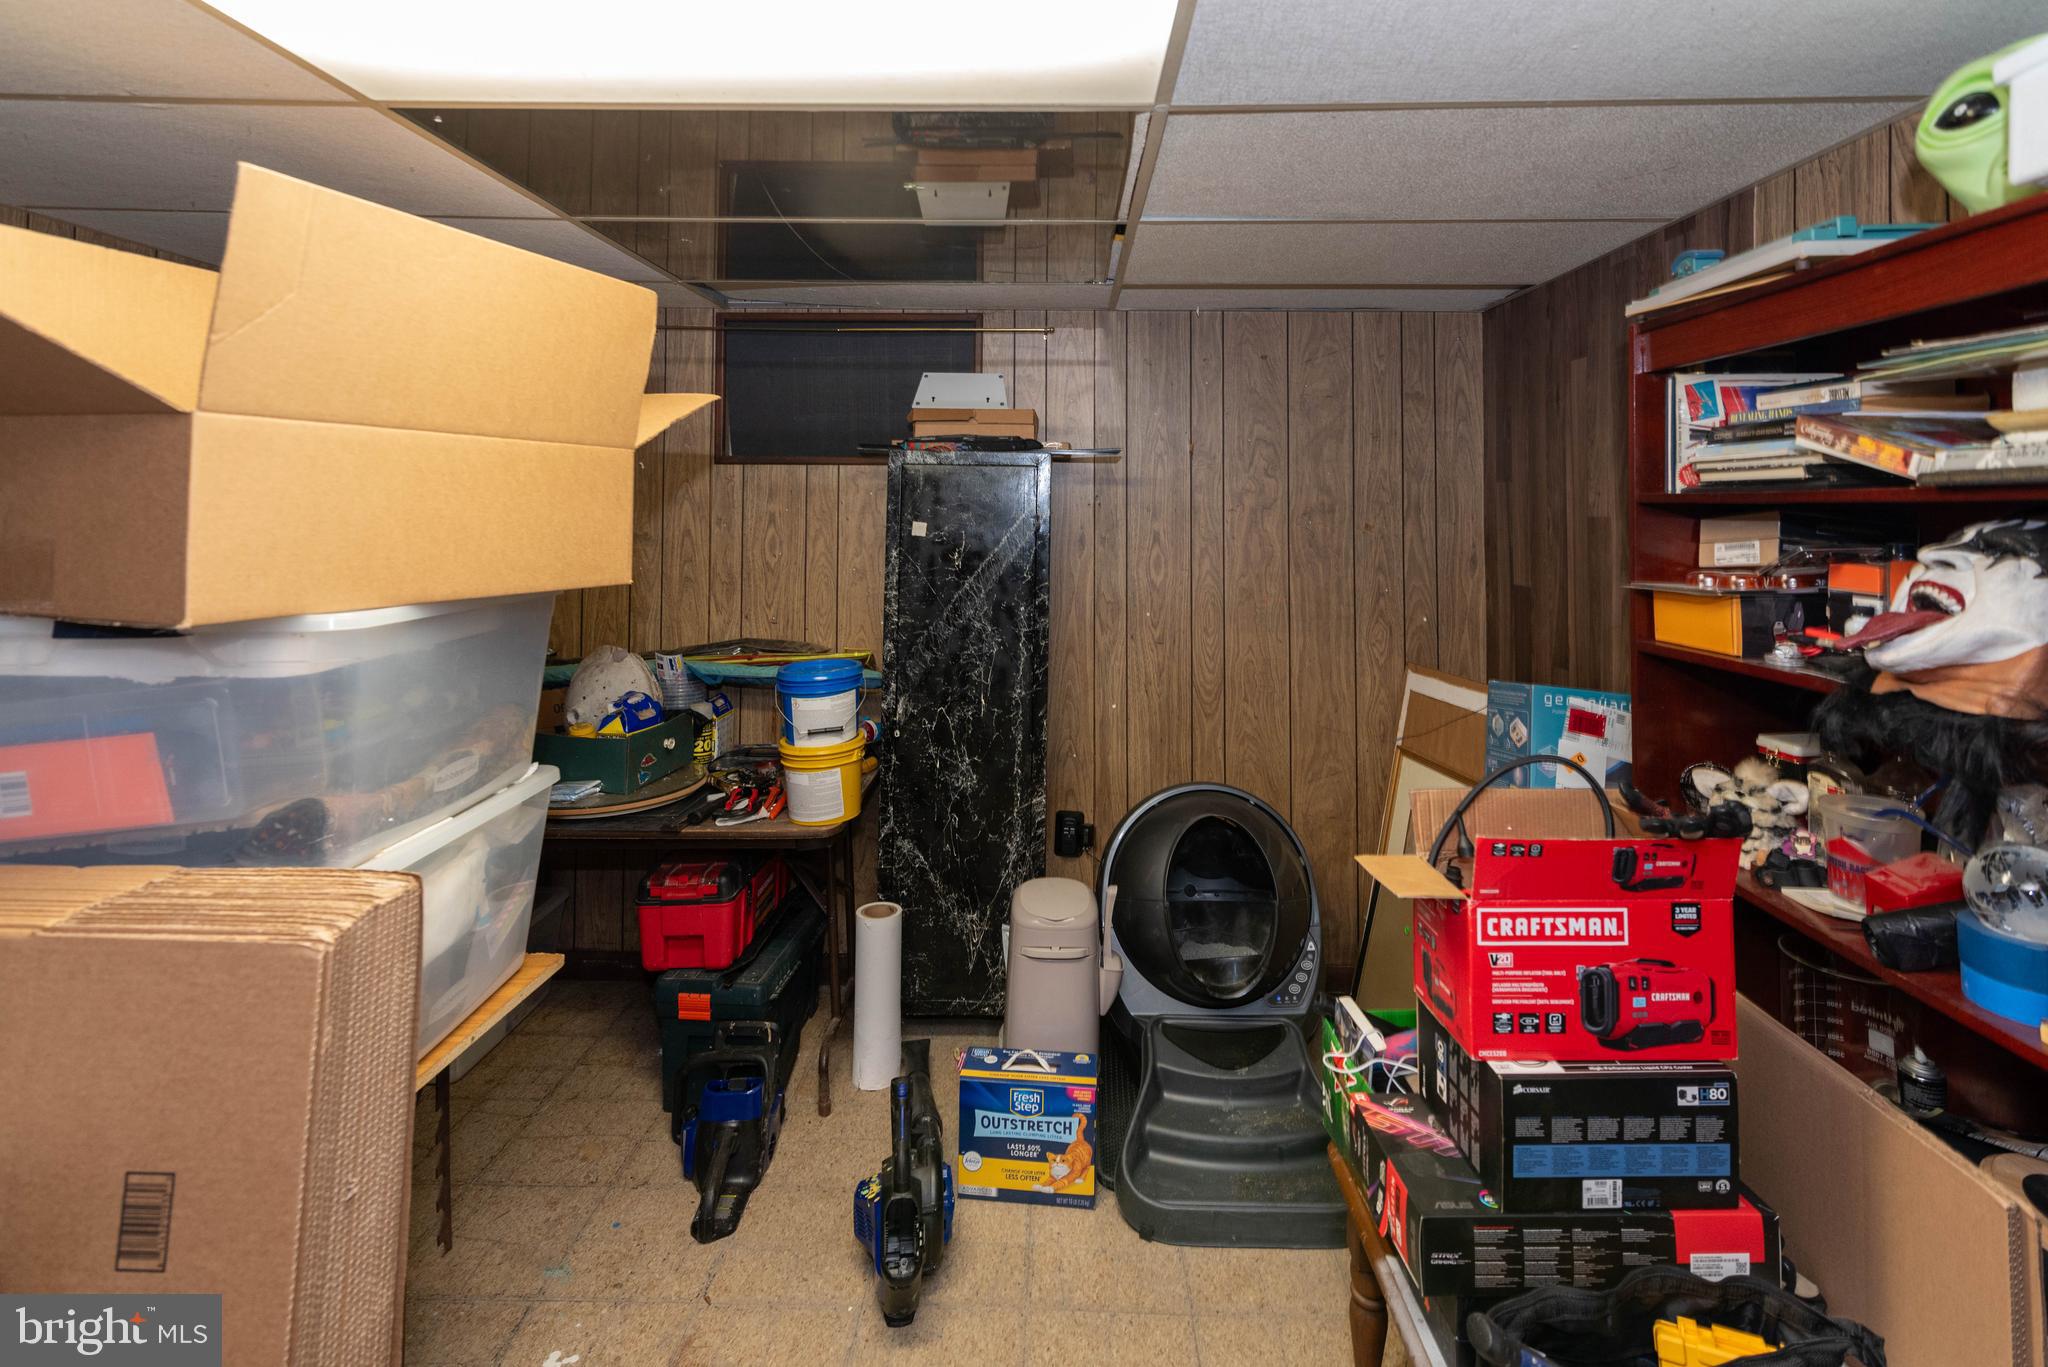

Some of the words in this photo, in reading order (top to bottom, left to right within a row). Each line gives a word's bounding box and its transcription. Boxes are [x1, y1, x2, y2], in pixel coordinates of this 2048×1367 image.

[1768, 408, 1793, 419] HANDS
[693, 740, 711, 753] 20
[1487, 917, 1619, 936] CRAFTSMAN
[1651, 992, 1690, 1002] CRAFTSMAN
[1522, 1086, 1551, 1094] CORSAIR
[1699, 1088, 1727, 1100] H80
[1013, 1092, 1040, 1103] Fresh
[1014, 1102, 1039, 1114] Step
[981, 1115, 1073, 1136] OUTSTRETCH
[1007, 1143, 1025, 1151] LASTS
[1027, 1144, 1041, 1152] 50%
